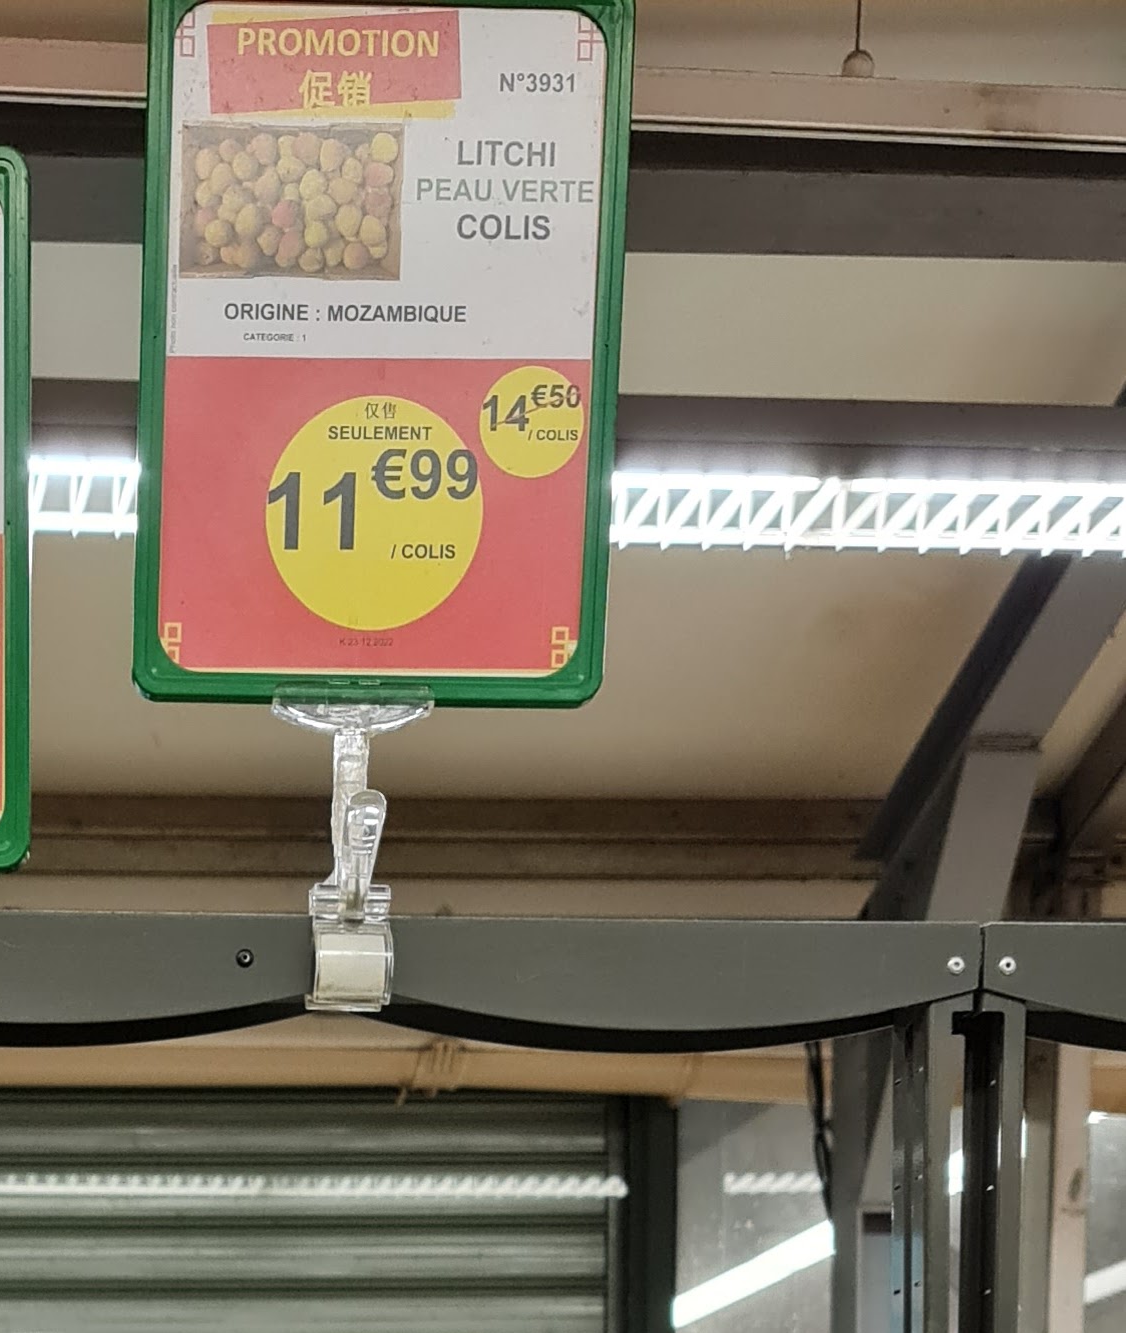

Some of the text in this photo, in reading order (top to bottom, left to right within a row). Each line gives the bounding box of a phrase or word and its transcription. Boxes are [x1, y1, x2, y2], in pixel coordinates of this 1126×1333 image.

[237, 27, 439, 58] PROMOTION
[298, 70, 372, 110] 促销
[499, 73, 575, 93] N°3931
[457, 141, 555, 167] LITCHI
[416, 179, 594, 203] PEAU VERTE
[457, 214, 550, 241] COLIS
[224, 303, 467, 323] ORIGINE MOZAMBIQUE
[364, 401, 397, 420] 仅售
[328, 425, 432, 441] SEULEMENT
[536, 429, 579, 442] COLIS
[401, 544, 456, 560] COLIS
